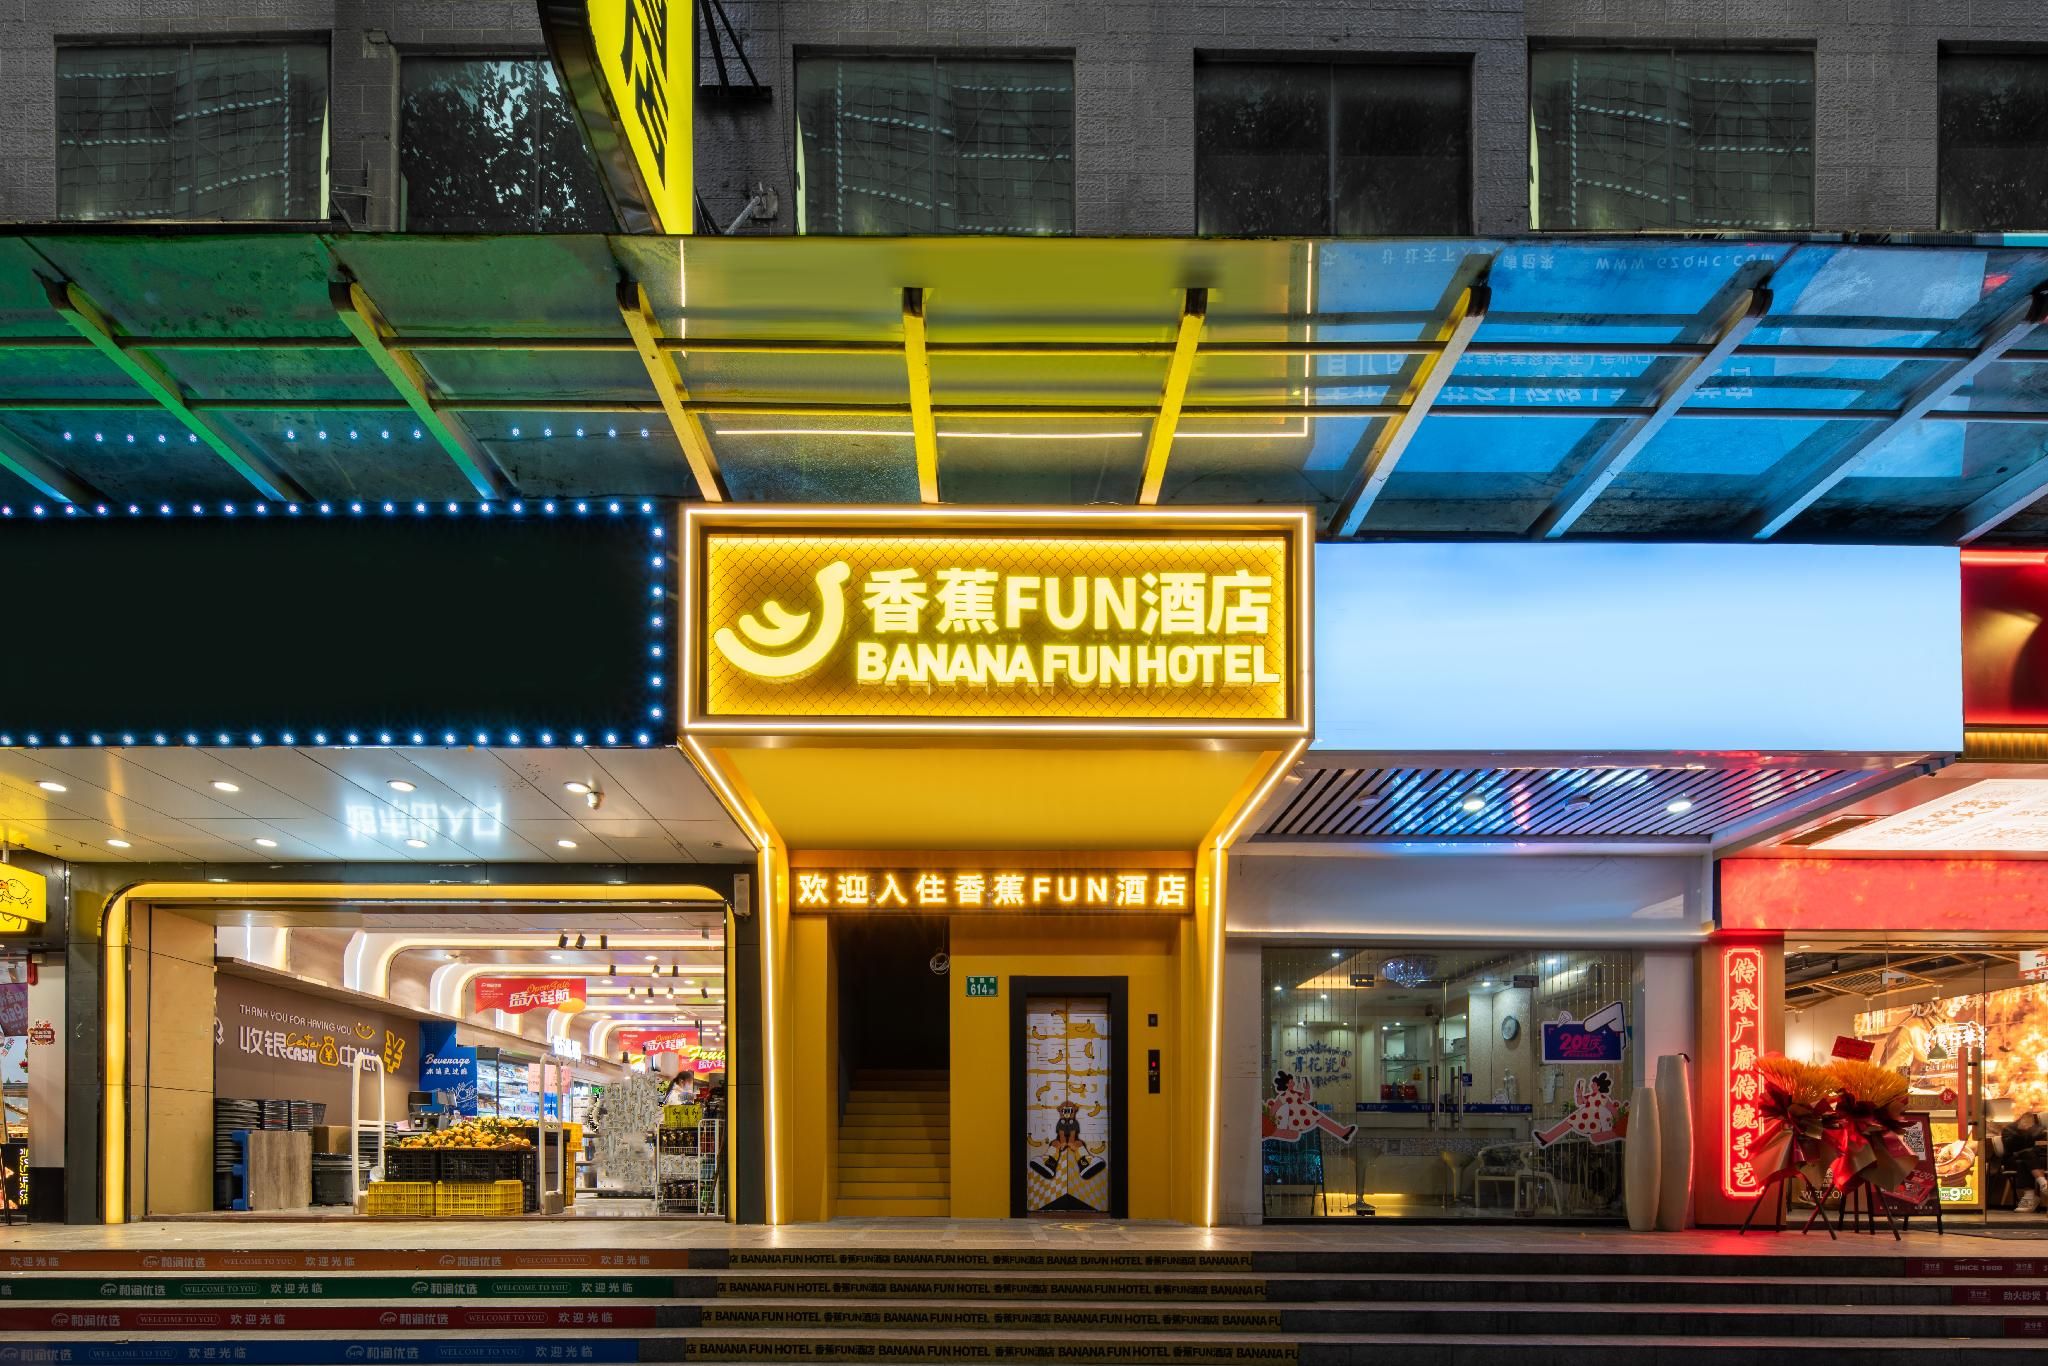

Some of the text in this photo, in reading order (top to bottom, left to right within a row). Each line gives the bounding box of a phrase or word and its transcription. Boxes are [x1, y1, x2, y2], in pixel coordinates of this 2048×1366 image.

[863, 567, 1273, 635] 香蕉FUN酒店
[856, 642, 1281, 686] BANANA FUN HOTEL
[798, 873, 1187, 907] 欢迎入住香蕉FUN酒店
[970, 983, 988, 995] 614
[239, 1004, 352, 1036] THANK YOU FOR HAVING YOU
[239, 1026, 288, 1059] 收银
[285, 1046, 317, 1064] CASH
[425, 1053, 470, 1067] Beverage
[1730, 957, 1760, 1187] 传承广府传统手艺
[10, 1256, 59, 1267] 欢迎光临
[305, 1256, 355, 1267] 欢迎光临
[600, 1255, 650, 1265] 欢迎光临
[741, 1255, 782, 1264] BANANA
[782, 1255, 802, 1264] FUN
[804, 1255, 837, 1264] HOTEL
[893, 1255, 933, 1264] BANANA
[933, 1255, 954, 1264] FUN
[956, 1256, 989, 1265] HOTEL
[1110, 1256, 1143, 1265] HOTEL
[1199, 1256, 1239, 1266] BANANA
[271, 1283, 323, 1295] 欢迎光临
[581, 1282, 633, 1293] 欢迎光临
[729, 1283, 772, 1292] BANANA
[773, 1283, 795, 1292] FUN
[796, 1283, 831, 1292] HOTEL
[890, 1283, 932, 1293] BANANA
[933, 1283, 955, 1293] FUN
[957, 1284, 990, 1293] HOTEL
[1051, 1284, 1094, 1294] BANANA
[1094, 1284, 1116, 1294] FUN
[1118, 1284, 1151, 1294] HOTEL
[1210, 1285, 1253, 1295] BANANA
[230, 1313, 286, 1326] 欢迎光临
[558, 1312, 613, 1323] 欢迎光临
[715, 1311, 760, 1321] BANANA
[761, 1311, 784, 1322] FUN
[785, 1312, 821, 1322] HOTEL
[883, 1312, 928, 1322] BANANA
[930, 1312, 952, 1322] FUN
[954, 1313, 990, 1323] HOTEL
[1053, 1313, 1098, 1324] BANANA
[1100, 1314, 1122, 1324] FUN
[1124, 1314, 1160, 1325] HOTEL
[1222, 1315, 1267, 1325] BANANA
[188, 1348, 246, 1359] 欢迎光临
[535, 1345, 593, 1358] 欢迎光临
[700, 1344, 748, 1354] BANANA
[749, 1344, 774, 1354] FUN
[775, 1344, 812, 1355] HOTEL
[878, 1345, 925, 1355] BANANA
[927, 1345, 950, 1356] FUN
[952, 1345, 990, 1357] HOTEL
[1058, 1346, 1105, 1357] BANANA
[1106, 1347, 1130, 1357] FUN
[1132, 1347, 1170, 1358] HOTEL
[1236, 1348, 1283, 1359] BANANA
